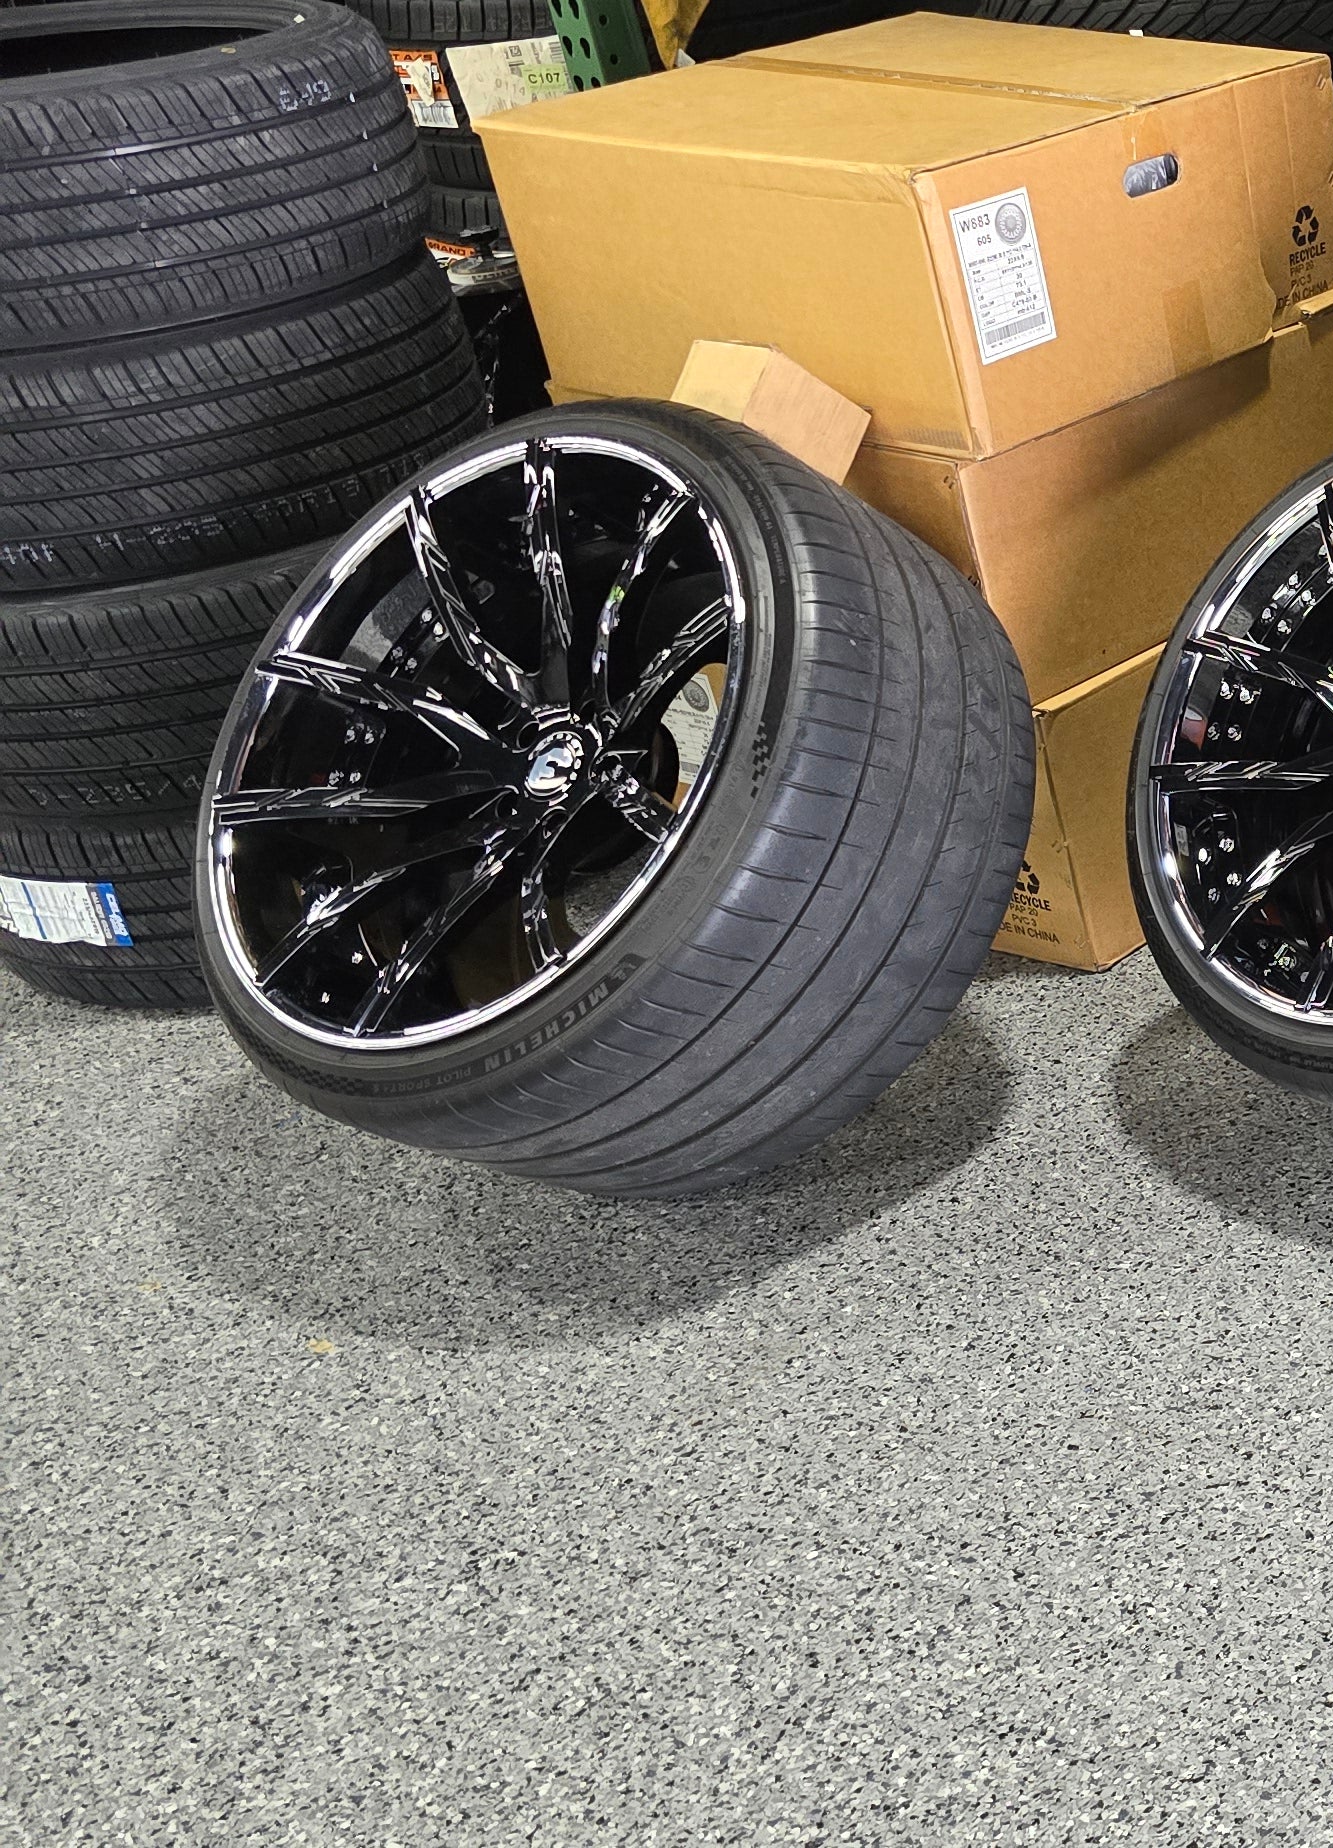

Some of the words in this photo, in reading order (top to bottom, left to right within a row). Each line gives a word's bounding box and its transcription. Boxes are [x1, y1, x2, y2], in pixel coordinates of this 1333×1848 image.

[528, 72, 561, 84] C107
[959, 213, 990, 233] W883
[977, 235, 992, 247] 605
[1289, 242, 1326, 267] RECYCLE
[1290, 264, 1305, 277] PAP
[1307, 274, 1311, 283] 3
[1292, 292, 1301, 304] IN
[1009, 903, 1026, 914] PAP
[1028, 907, 1038, 917] 20
[1012, 914, 1029, 926] PVC
[1032, 919, 1037, 927] 3
[999, 922, 1013, 933] DE
[1014, 926, 1026, 936] IN
[1027, 927, 1061, 945] CHINA
[483, 982, 609, 1073] MICHELIN
[436, 1066, 471, 1084] PILOT
[386, 1077, 431, 1093] SPORT
